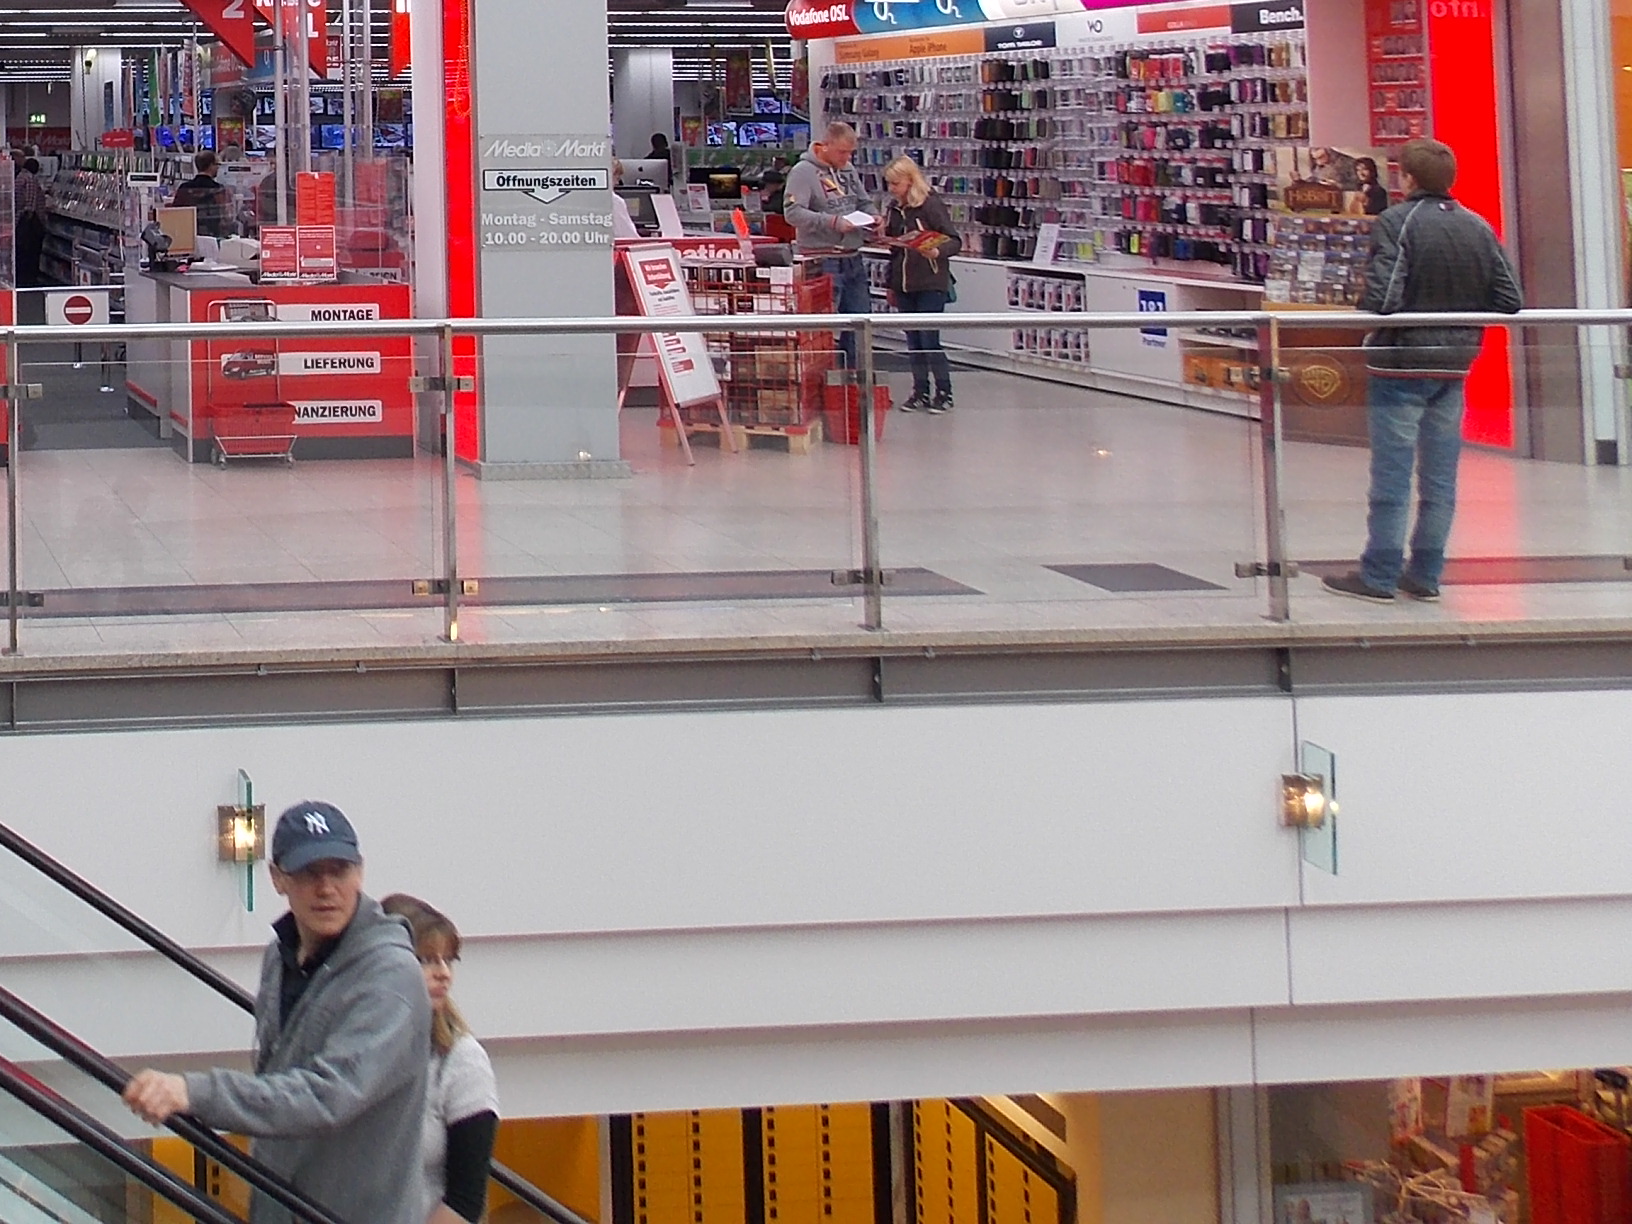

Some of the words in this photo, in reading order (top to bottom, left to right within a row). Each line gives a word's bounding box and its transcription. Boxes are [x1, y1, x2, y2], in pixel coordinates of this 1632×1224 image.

[788, 7, 830, 26] Vodafone
[1259, 6, 1304, 25] Bench.
[484, 140, 541, 158] Media
[554, 139, 606, 157] Markt
[496, 172, 597, 189] Öffnungszeiten
[482, 214, 537, 227] Montag
[549, 213, 613, 227] Samstag
[485, 232, 527, 244] 10.00
[539, 231, 581, 244] 20.00
[585, 230, 610, 244] Uhr
[311, 309, 373, 321] MONTAGE
[304, 358, 374, 369] LIEFERUNG
